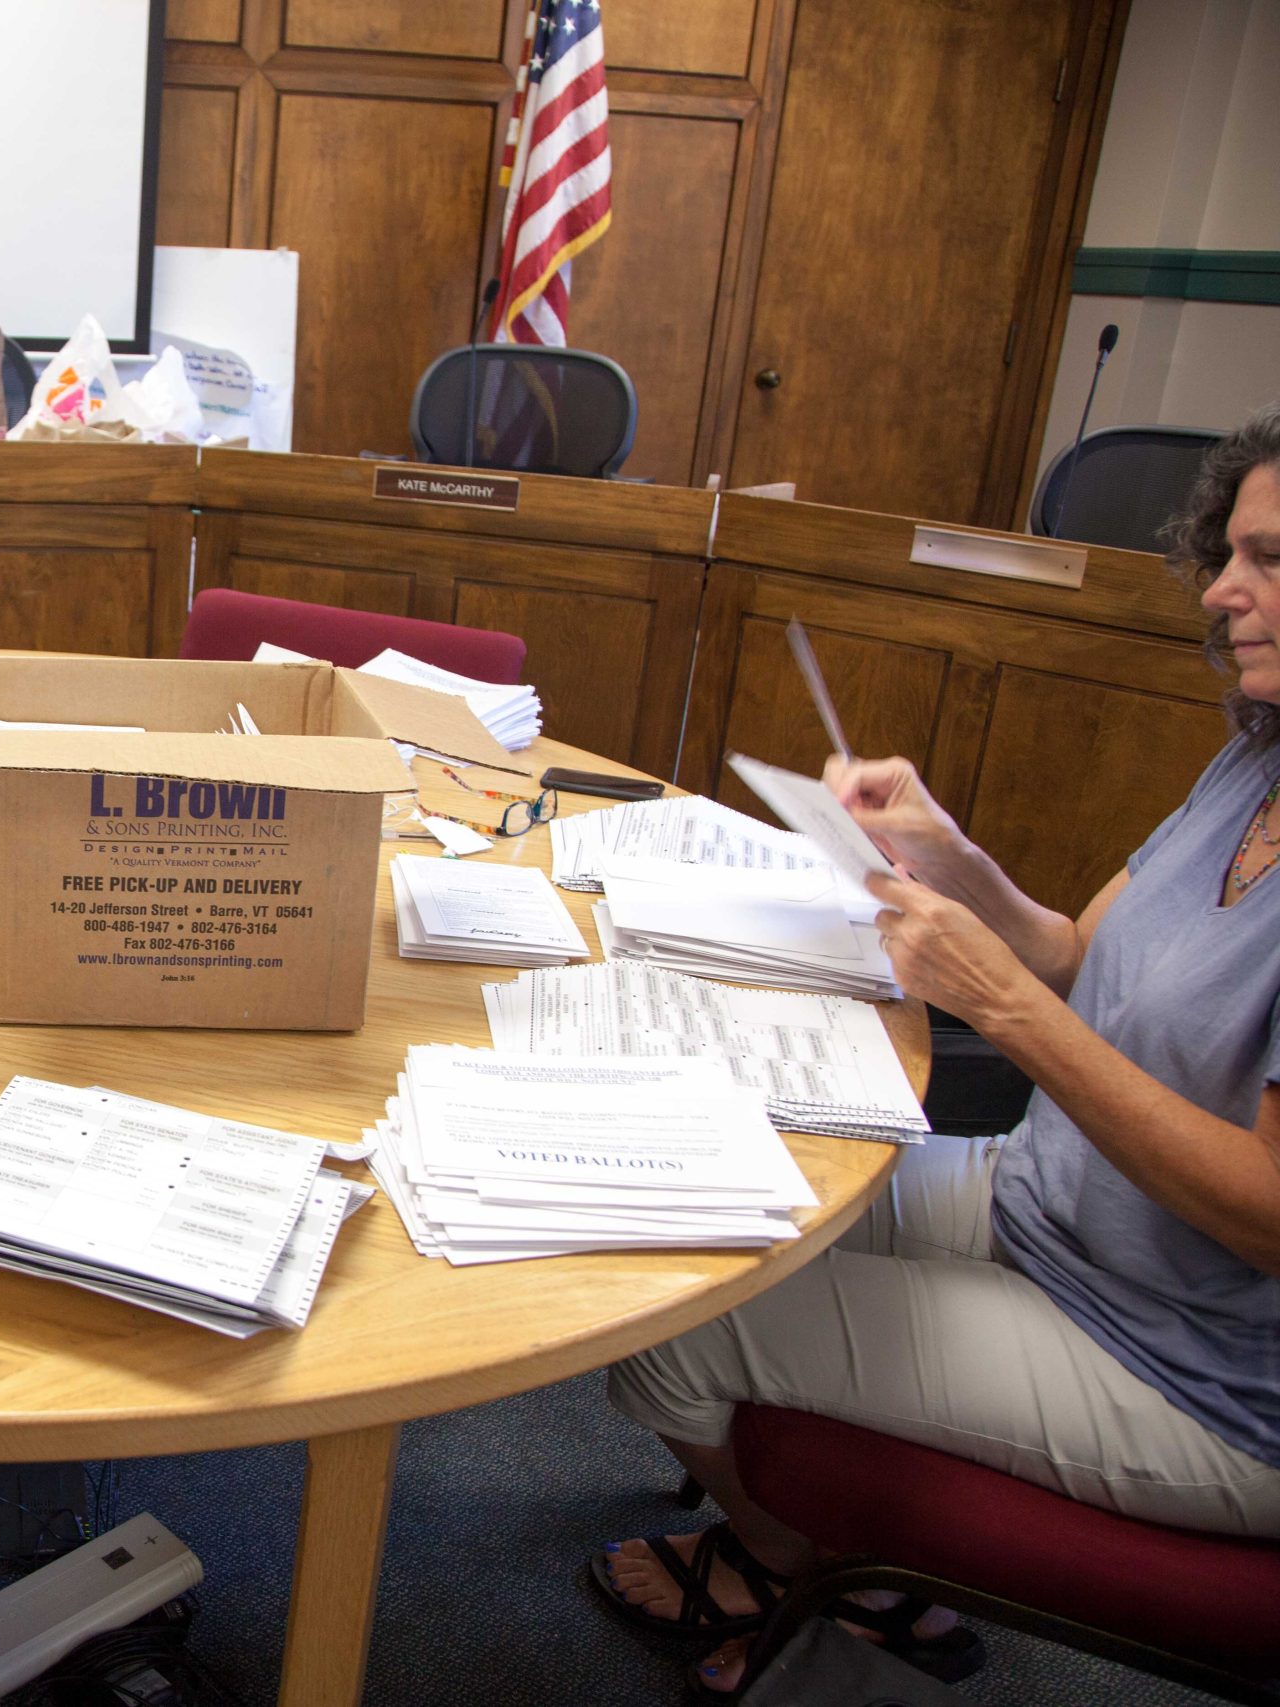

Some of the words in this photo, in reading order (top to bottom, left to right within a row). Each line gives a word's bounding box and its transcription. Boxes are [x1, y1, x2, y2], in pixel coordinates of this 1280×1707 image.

[398, 479, 428, 492] KATE
[430, 481, 495, 498] McCARTHY
[90, 774, 123, 818] L.
[86, 823, 102, 835] &
[107, 822, 149, 836] SONS
[158, 822, 244, 838] PRINTING,
[252, 824, 287, 838] INC.
[84, 844, 155, 854] DESIGN
[171, 845, 229, 855] PRINT
[244, 847, 287, 856] MAIL
[123, 858, 160, 868] QUALITY
[164, 859, 210, 867] VERMONT
[63, 876, 103, 891] FREE
[110, 877, 178, 892] PICK-UP
[184, 879, 217, 893] AND
[223, 880, 301, 895] DELIVERY
[50, 902, 85, 914] 14-20
[89, 903, 148, 916] Jefferson
[152, 904, 188, 916] Street
[210, 905, 248, 918] Barre,
[252, 906, 268, 918] VT
[276, 907, 313, 918] 05641
[84, 920, 169, 933] 800-486-1947
[191, 922, 277, 934] 802-476-3164
[124, 938, 145, 949] Fax
[149, 939, 235, 951] 802-476-3166
[78, 954, 282, 969] www.lbrownandsonsprinting.com
[497, 1149, 568, 1163] VOTED
[575, 1155, 684, 1171] BALLOT(S)
